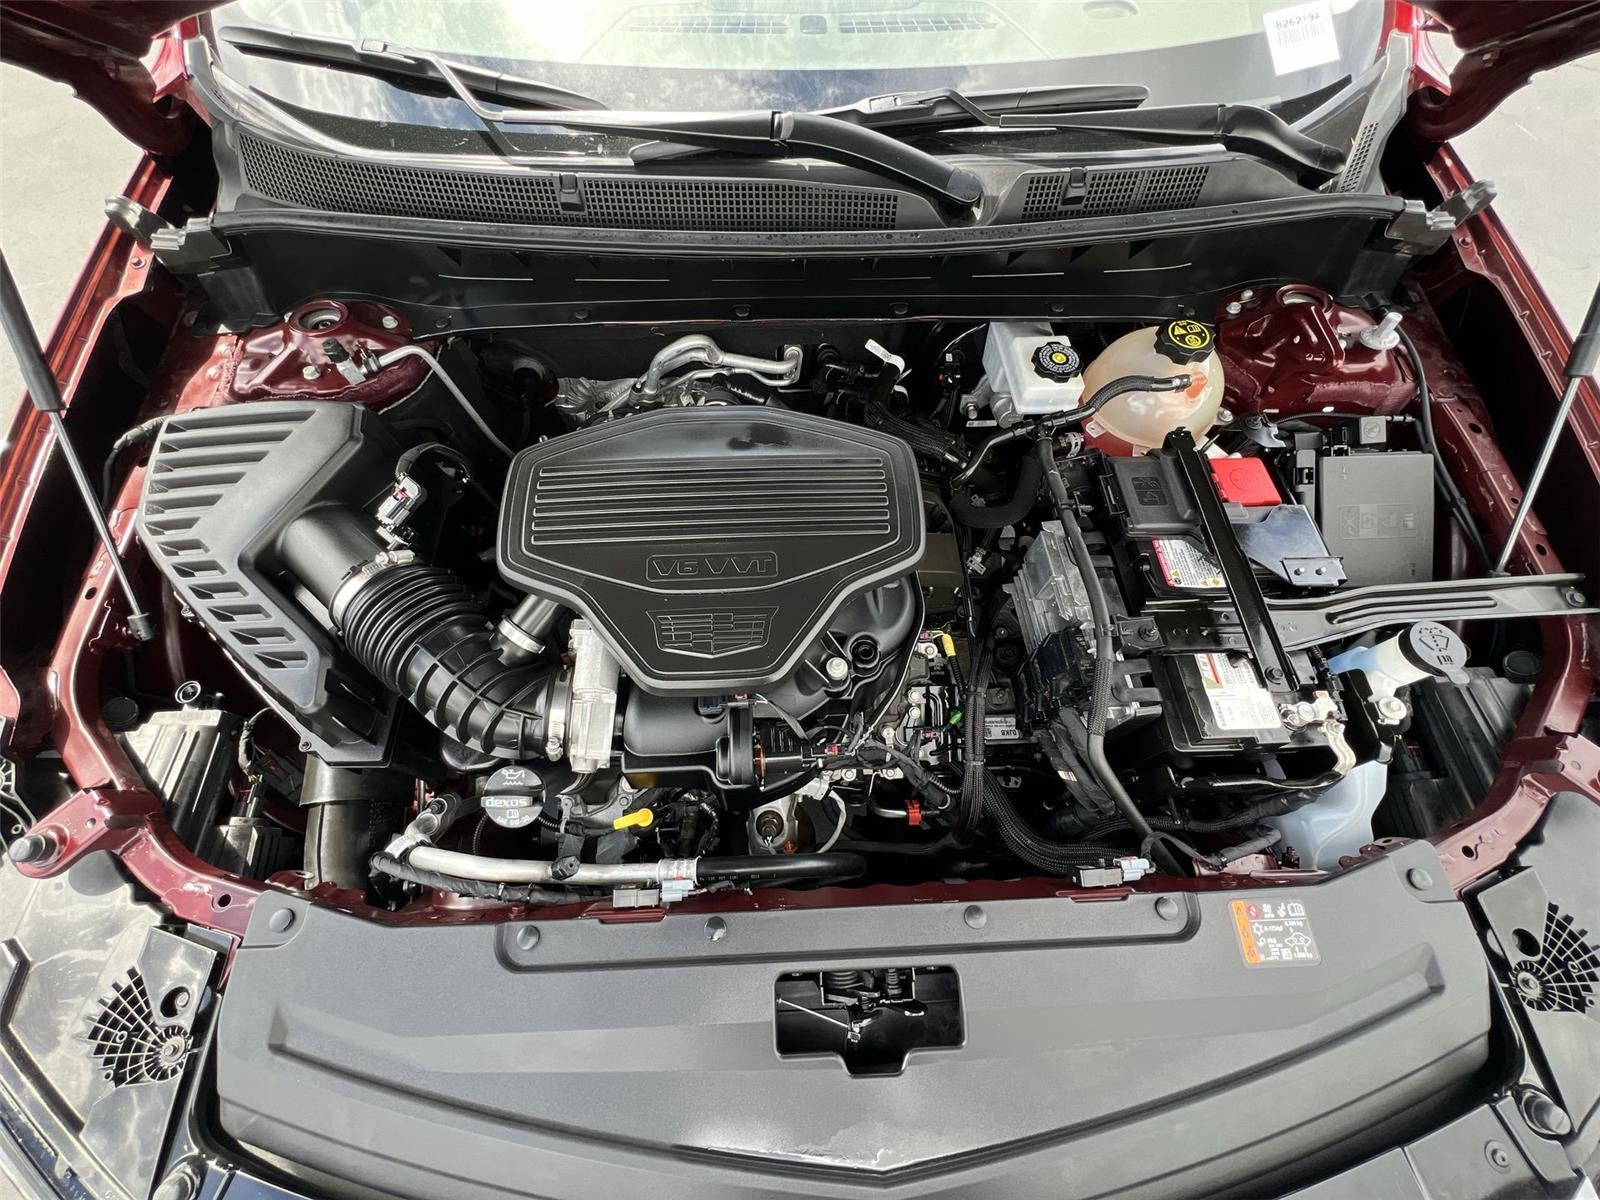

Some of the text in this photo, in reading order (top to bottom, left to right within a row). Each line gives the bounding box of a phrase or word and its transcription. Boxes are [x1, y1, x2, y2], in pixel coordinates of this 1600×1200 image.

[652, 556, 773, 576] V6 VVT
[485, 796, 528, 808] dexos
